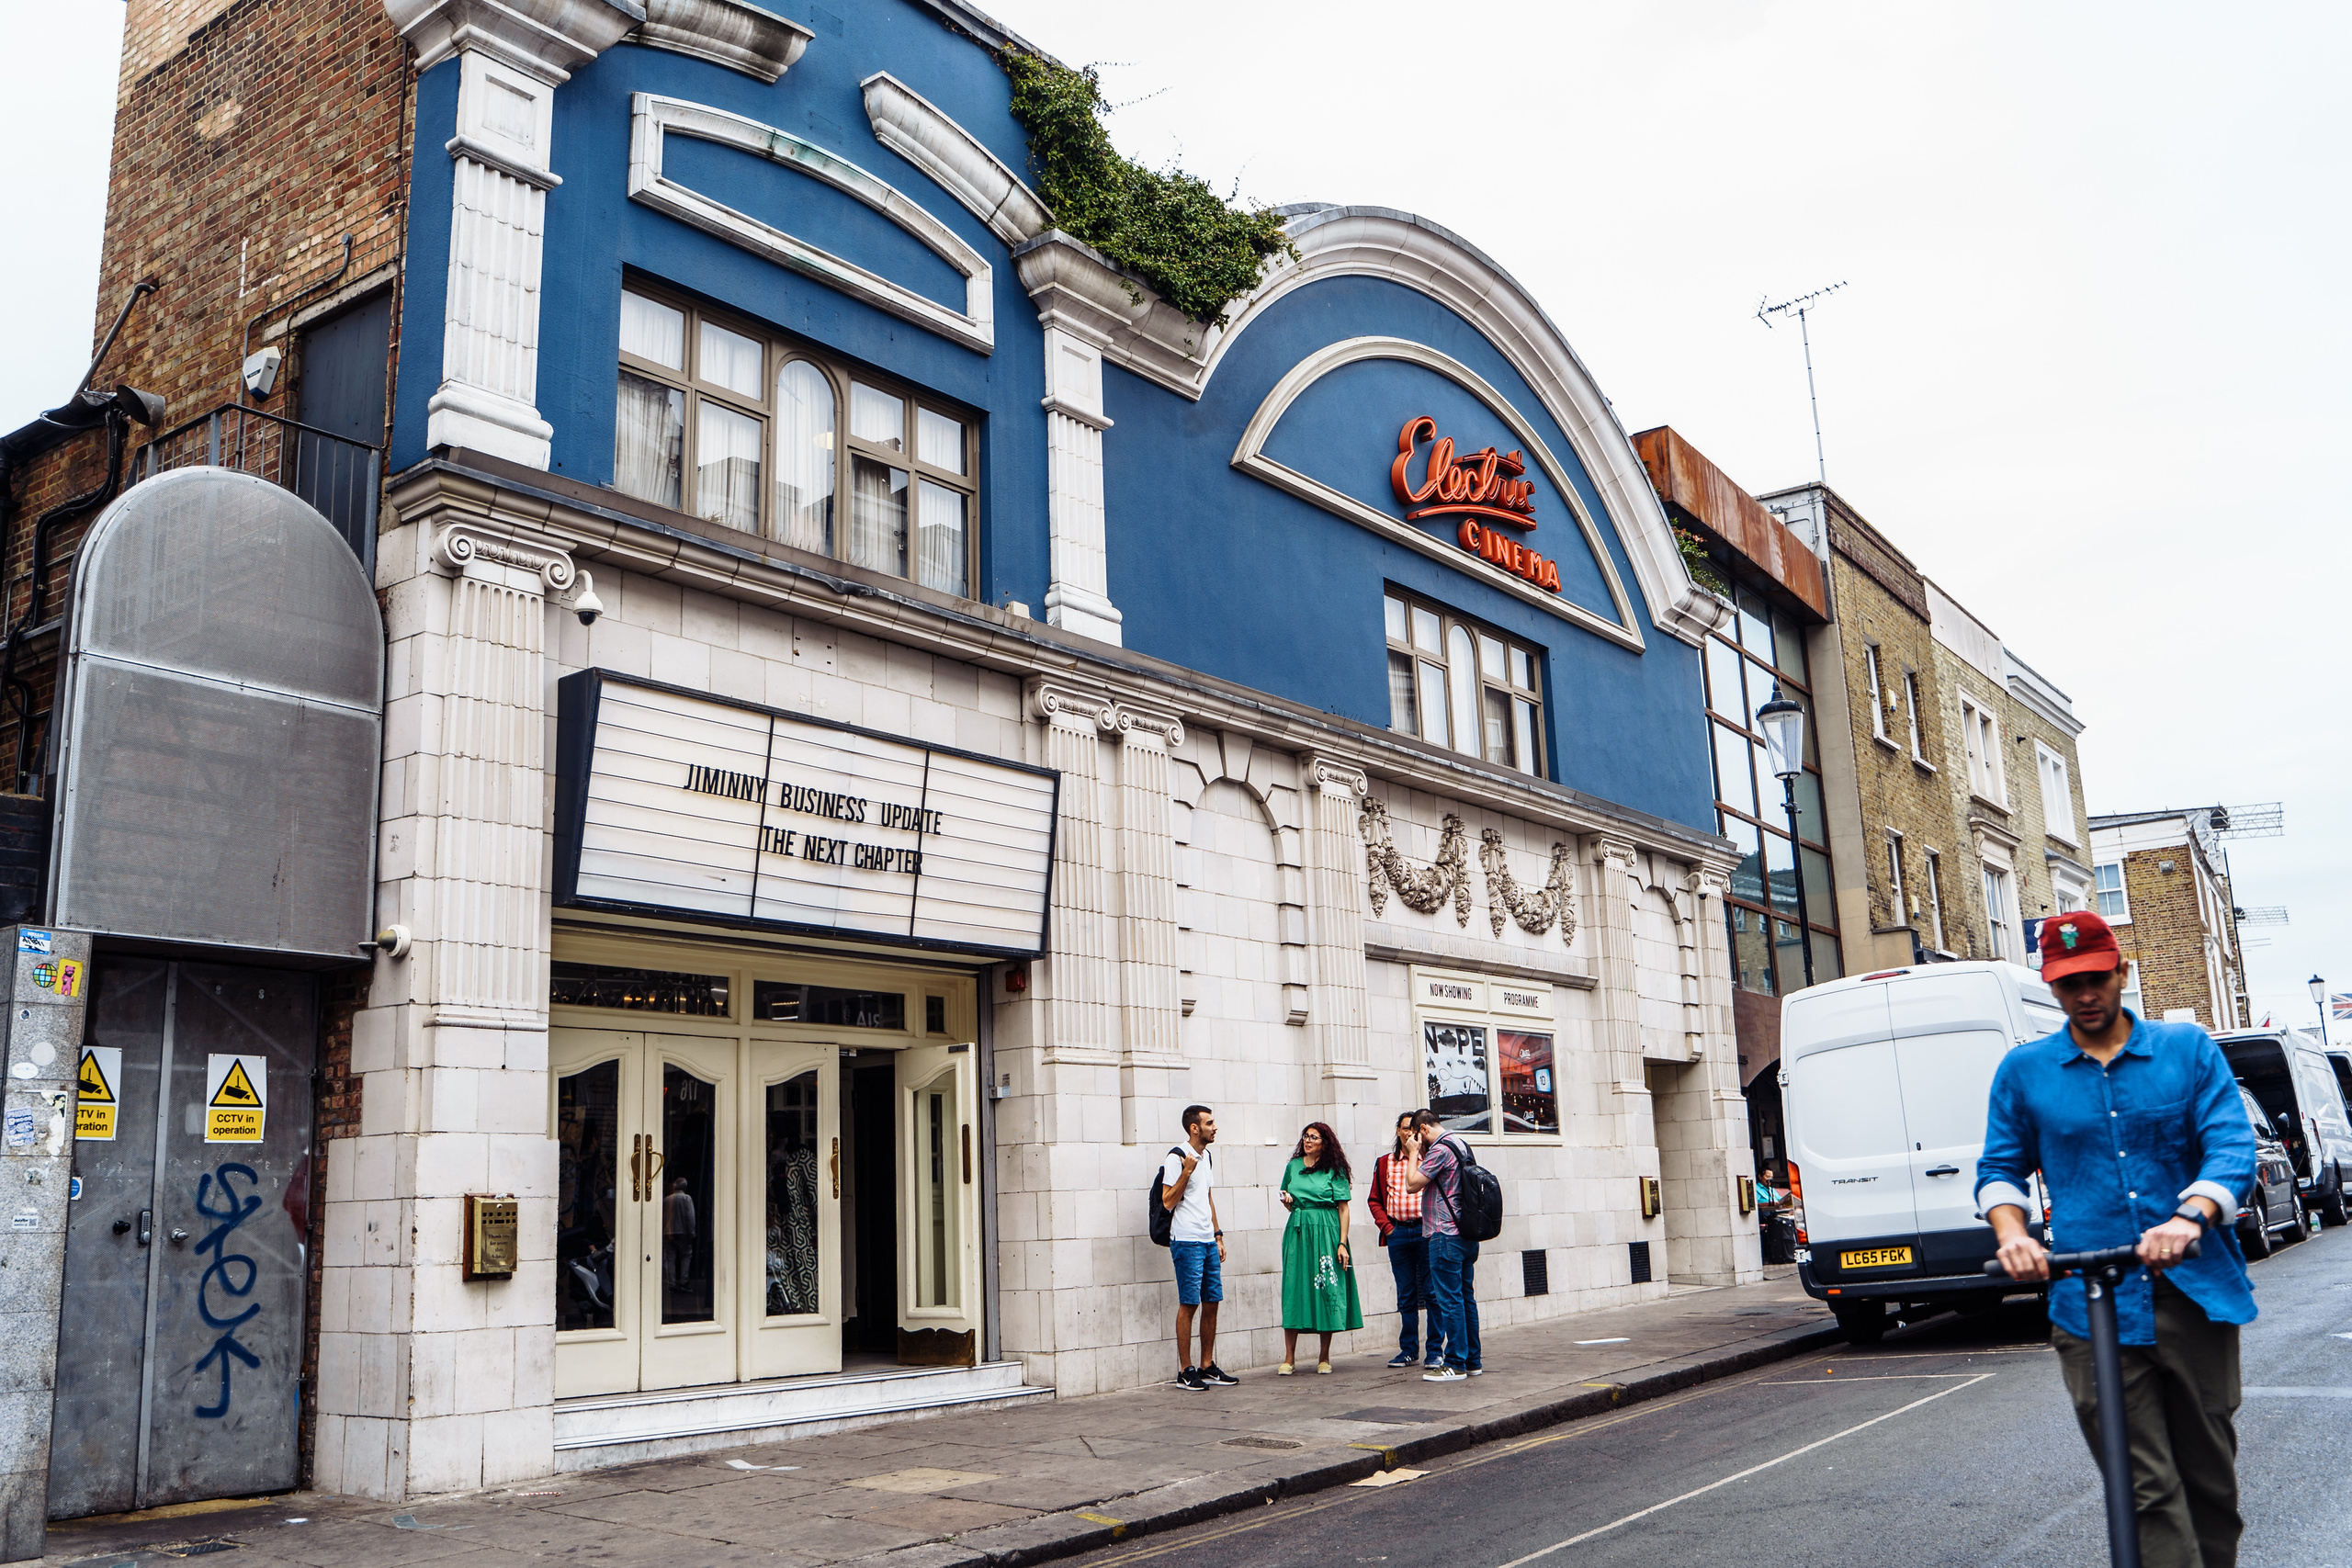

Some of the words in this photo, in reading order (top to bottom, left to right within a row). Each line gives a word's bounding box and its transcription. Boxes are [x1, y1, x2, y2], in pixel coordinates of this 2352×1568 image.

[1391, 415, 1536, 514] Electric
[1458, 518, 1562, 593] CINEMA
[684, 763, 767, 804] JIMINNY
[780, 783, 867, 823] BUSINESS
[881, 802, 944, 836] UPDATE
[762, 826, 795, 856] THE
[803, 834, 849, 866] NEXT
[854, 842, 923, 875] CHAPTER
[1430, 983, 1444, 998] NOW
[1444, 985, 1472, 1000] SHOWING
[1504, 992, 1539, 1008] PROGRAMME
[1425, 1026, 1485, 1056] NOPE
[77, 1110, 94, 1118] TV
[96, 1110, 106, 1119] in
[217, 1114, 243, 1123] CCTV
[246, 1114, 254, 1123] in
[75, 1122, 107, 1132] eration
[212, 1126, 256, 1135] operation
[1831, 1177, 1879, 1185] TRANSIT
[1846, 1251, 1878, 1266] LC65
[1881, 1249, 1906, 1263] FGK
